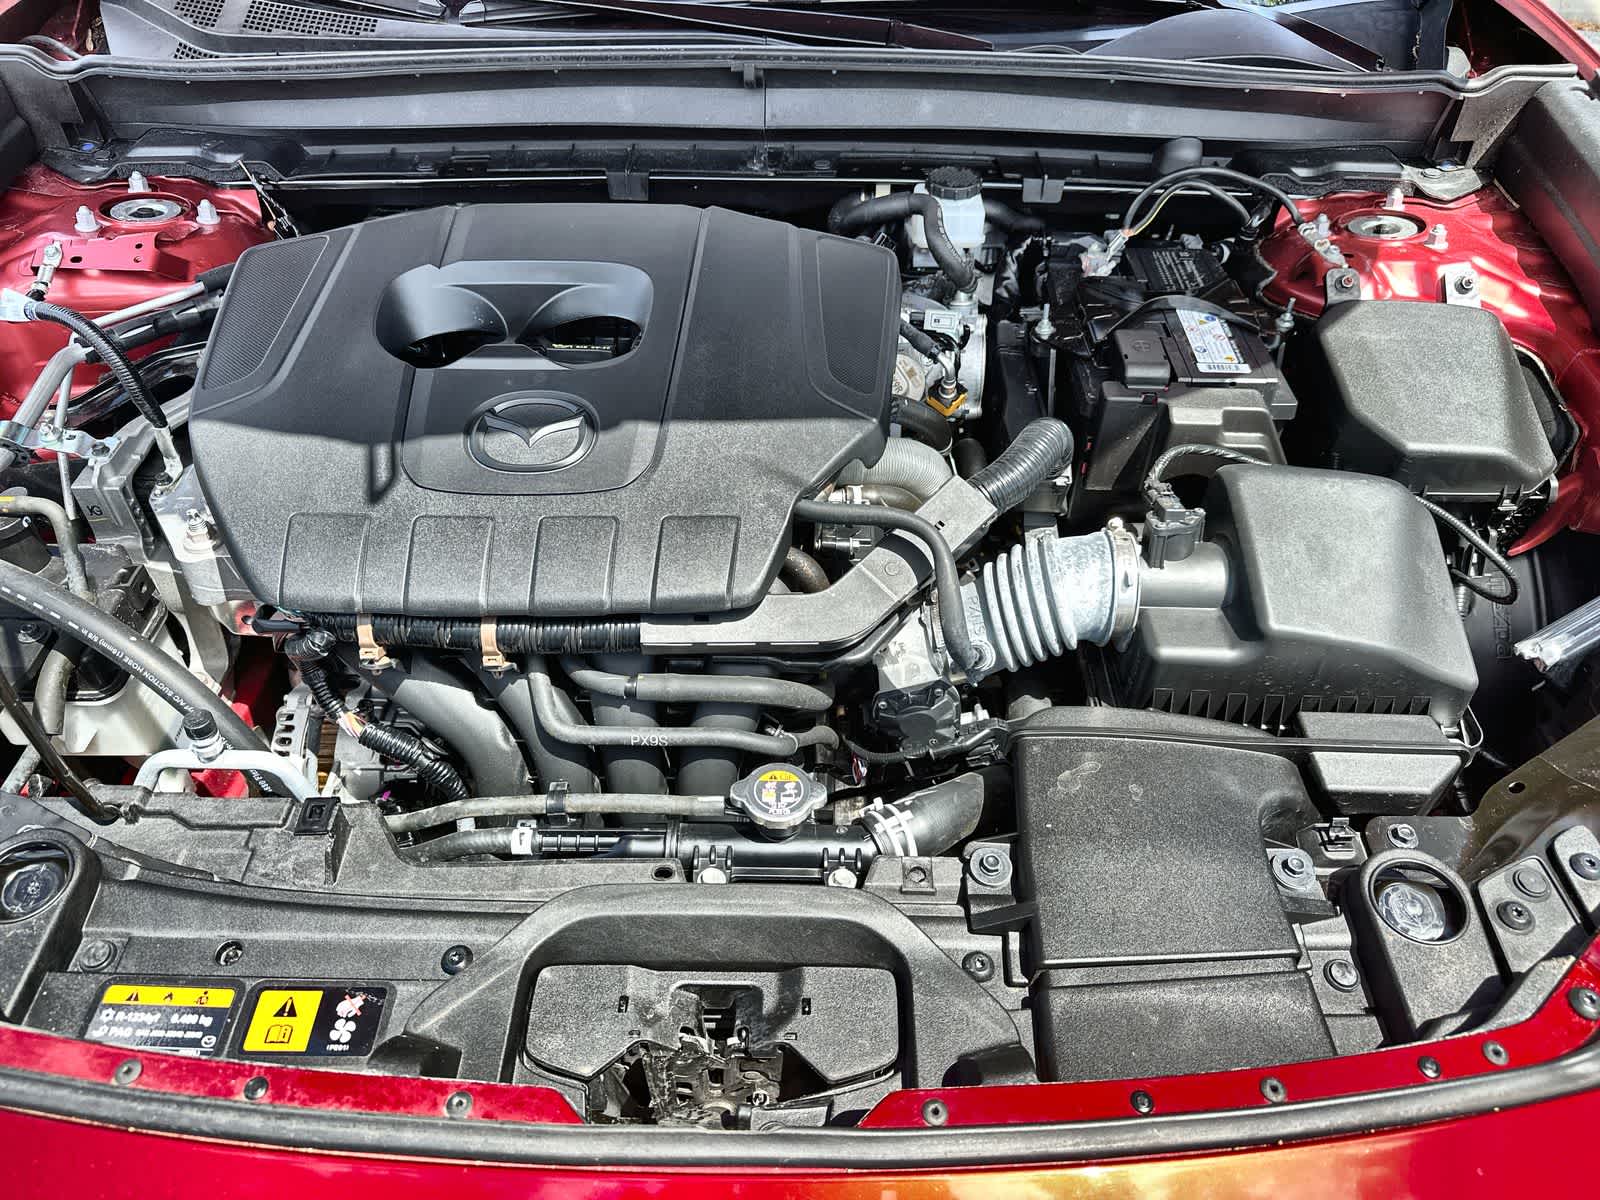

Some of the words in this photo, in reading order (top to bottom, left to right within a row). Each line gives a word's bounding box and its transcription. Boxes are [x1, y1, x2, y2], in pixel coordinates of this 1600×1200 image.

[98, 639, 124, 658] (16mm)
[122, 655, 144, 673] HOSE
[142, 671, 174, 697] SUCTION
[172, 695, 188, 708] A/C
[630, 734, 669, 746] PX9S
